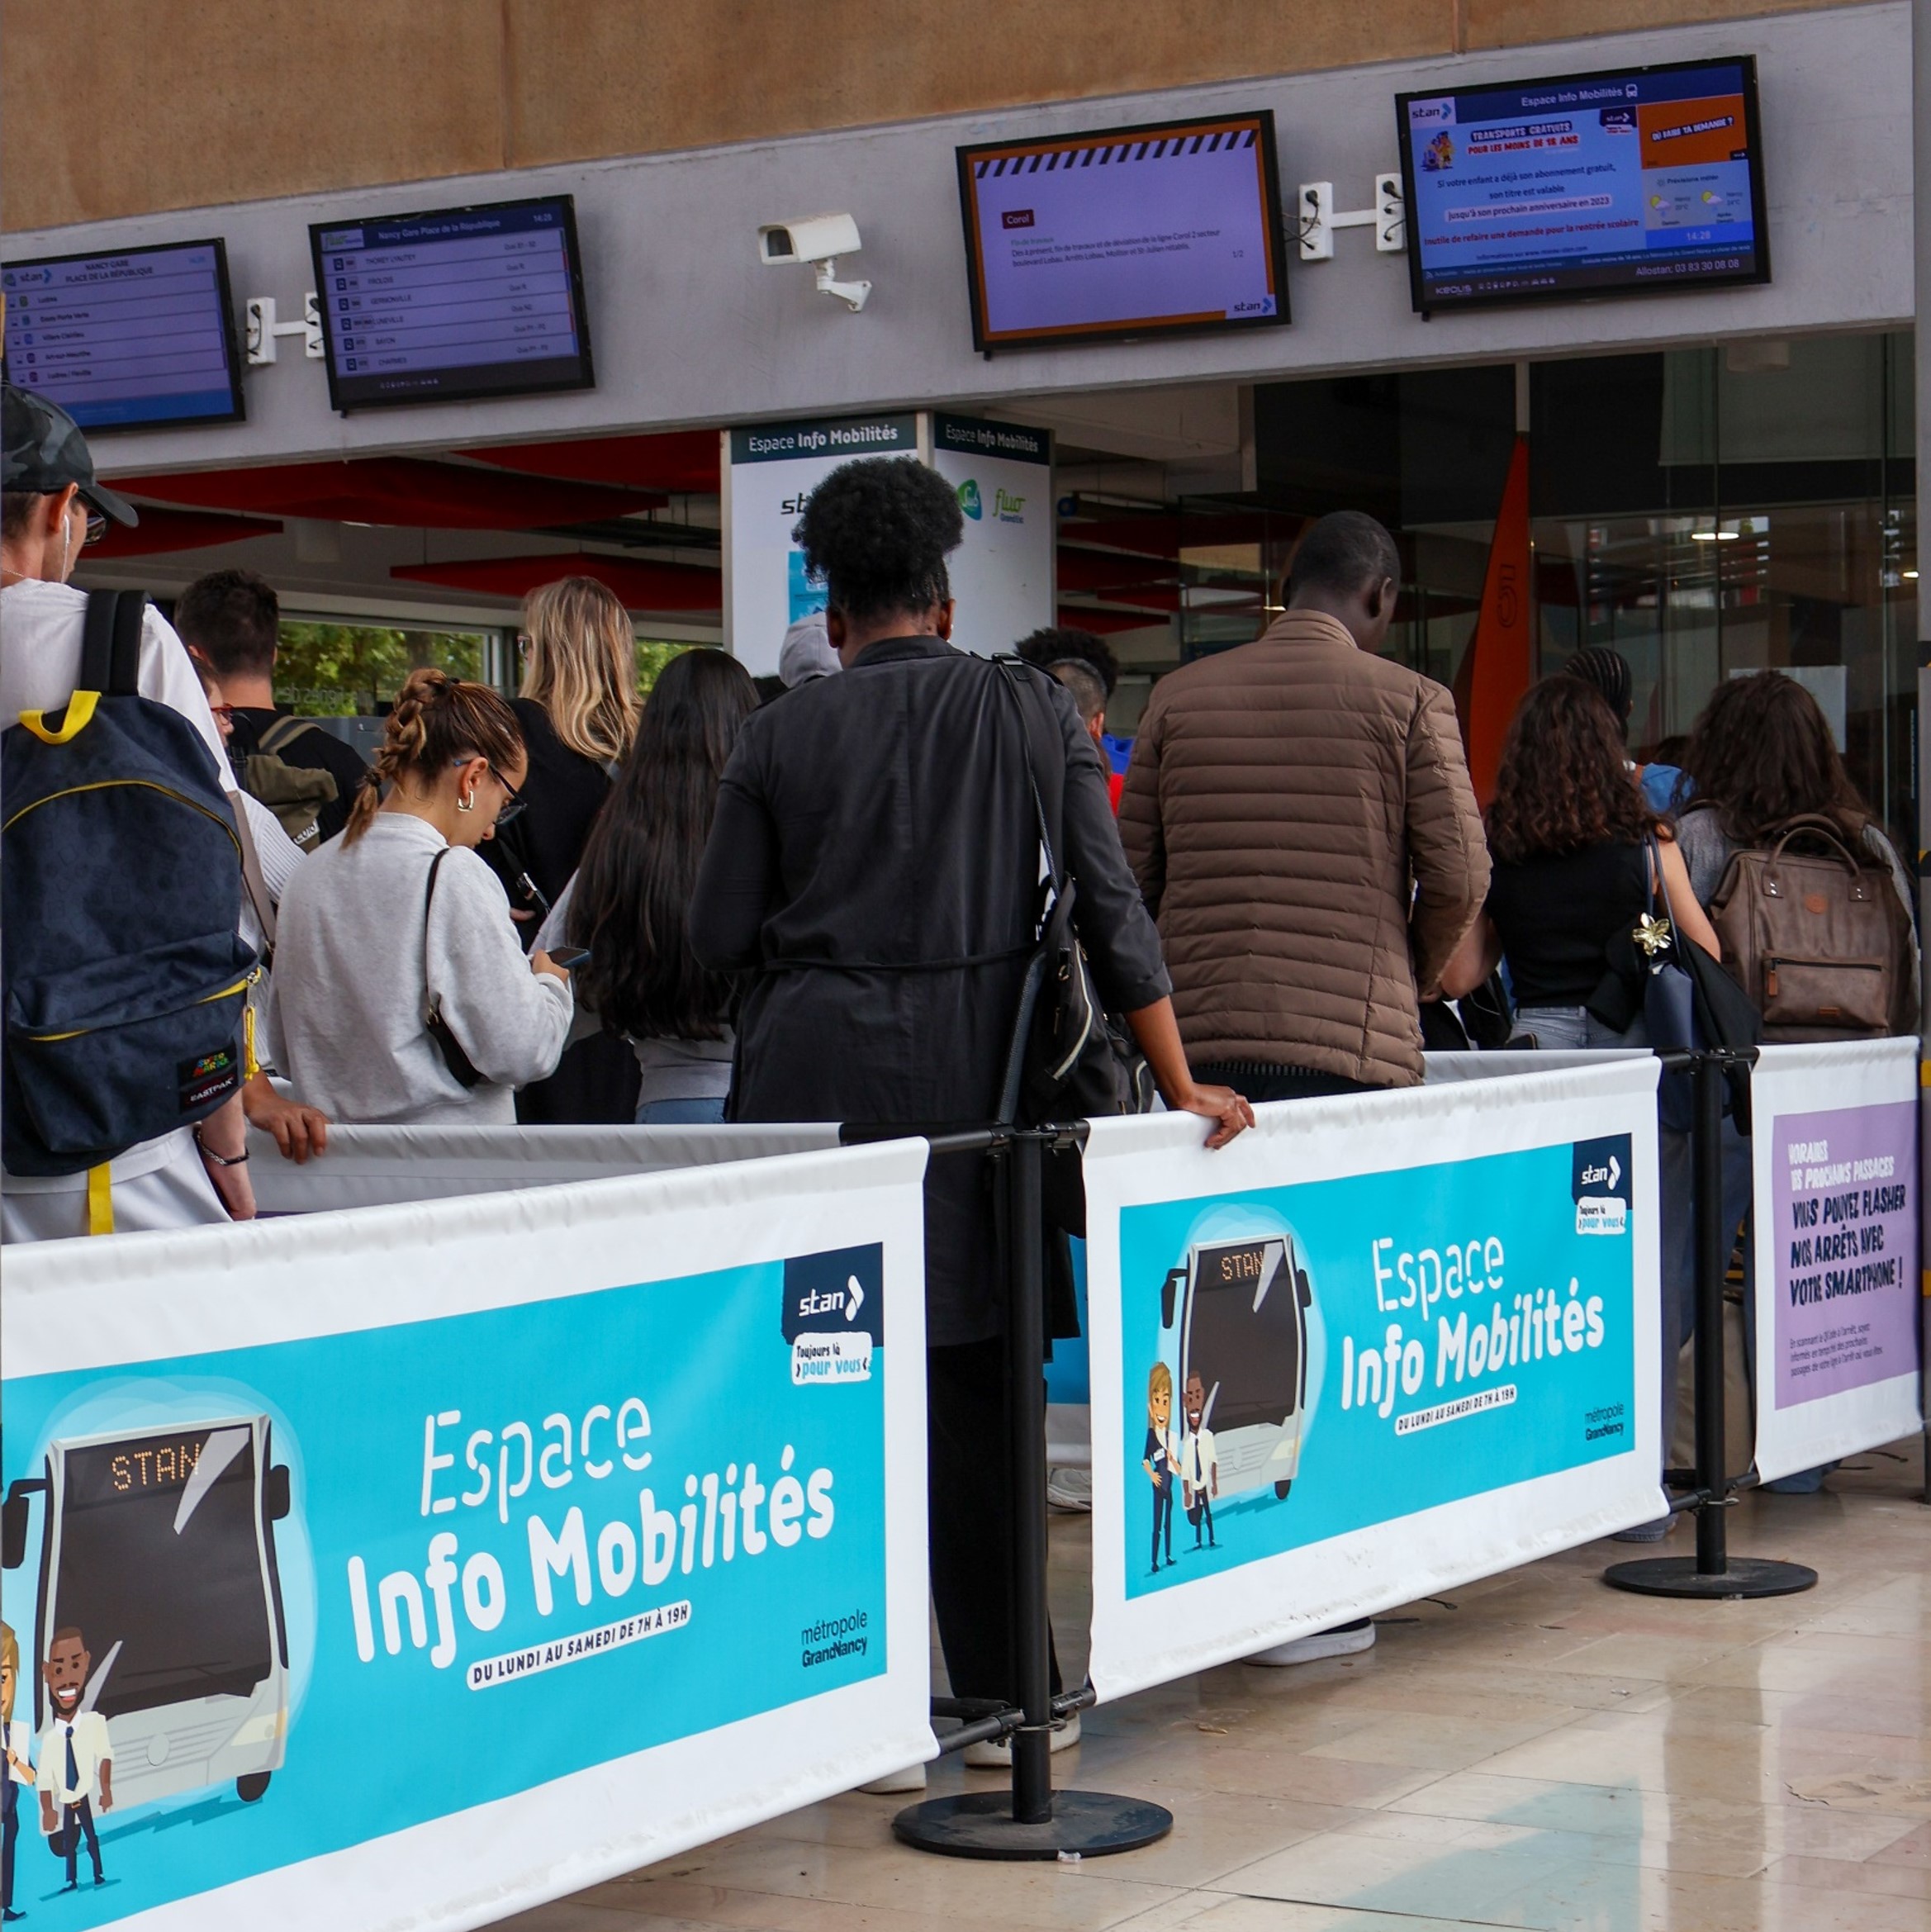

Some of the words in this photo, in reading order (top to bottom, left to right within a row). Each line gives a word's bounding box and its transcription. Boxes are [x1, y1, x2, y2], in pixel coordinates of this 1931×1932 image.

[1521, 96, 1556, 108] Espace
[1559, 92, 1577, 102] Info
[1579, 87, 1623, 100] Mobilités
[1412, 107, 1440, 118] stan
[1472, 126, 1526, 142] TRANSPORTS
[1530, 122, 1571, 135] GRATUITS
[1468, 145, 1488, 155] POUR
[1490, 143, 1502, 152] LES
[1504, 140, 1530, 150] MOINS
[1533, 139, 1544, 149] DE
[1559, 135, 1579, 145] ANS
[1437, 179, 1445, 188] Si
[1446, 178, 1467, 187] votre
[1468, 175, 1493, 185] enfant
[1501, 172, 1517, 183] déjà
[1535, 167, 1585, 178] abonnement
[1587, 163, 1616, 175] gratuit,
[1489, 192, 1504, 200] son
[1505, 189, 1521, 197] titre
[1536, 185, 1565, 195] valable
[1478, 209, 1492, 217] son
[1493, 205, 1527, 216] prochain
[1529, 200, 1578, 211] anniversaire
[1590, 196, 1610, 206] 2023
[378, 230, 401, 241] Nancy
[402, 229, 420, 238] Gare
[420, 226, 439, 235] Place
[442, 224, 451, 232] de
[452, 223, 459, 231] la
[460, 219, 501, 231] République
[1006, 213, 1030, 225] Corol
[1173, 231, 1191, 240] Corol
[1197, 230, 1220, 238] secteur
[1425, 235, 1449, 245] Inutile
[1451, 235, 1461, 243] de
[1463, 233, 1489, 242] refaire
[1490, 231, 1506, 240] une
[1507, 227, 1544, 238] demande
[1545, 227, 1564, 236] pour
[1566, 224, 1573, 232] la
[1575, 220, 1605, 231] rentrée
[1606, 218, 1639, 229] scolaire
[1687, 230, 1711, 240] 14:28
[85, 260, 109, 270] NANCY
[110, 259, 129, 268] GARE
[1013, 258, 1043, 268] boulevard
[1635, 265, 1673, 276] Allostan:
[1674, 263, 1686, 273] 03
[1687, 263, 1700, 272] 83
[1701, 261, 1713, 271] 30
[1715, 260, 1726, 270] 08
[1728, 259, 1739, 268] 08
[19, 272, 42, 282] stan
[65, 274, 88, 282] PLACE
[88, 273, 98, 281] DE
[1234, 301, 1261, 312] stan
[749, 435, 795, 453] Espace
[797, 432, 826, 450] Info
[830, 423, 899, 444] Mobilités
[946, 425, 976, 443] Espace
[977, 429, 996, 445] Info
[996, 430, 1039, 453] Mobilités
[190, 1077, 233, 1102] EASTPAK
[1788, 1140, 1829, 1165] HORAIRES
[1581, 1164, 1608, 1184] stan
[1805, 1162, 1852, 1189] PROCHAINS
[1853, 1156, 1895, 1183] PASSAGES
[1579, 1205, 1599, 1217] Toujours
[1792, 1199, 1819, 1229] VOUS
[1823, 1191, 1859, 1224] POUVEZ
[1862, 1184, 1906, 1217] FLASHER
[1582, 1218, 1600, 1231] pour
[1601, 1217, 1620, 1228] vous
[1791, 1237, 1812, 1270] NOS
[1815, 1223, 1858, 1263] ARRÊTS
[1861, 1224, 1884, 1255] AVEC
[1221, 1251, 1264, 1281] STAN
[1372, 1236, 1504, 1322] Espace
[1790, 1274, 1823, 1307] VOTRE
[1825, 1258, 1895, 1300] SMARTPHONE
[1898, 1256, 1903, 1289] !
[798, 1289, 845, 1317] stan
[796, 1344, 830, 1360] Toujours
[833, 1341, 840, 1355] là
[1341, 1323, 1425, 1418] Info
[1435, 1277, 1605, 1387] Mobilités
[802, 1361, 831, 1379] pour
[836, 1358, 861, 1374] vous
[1398, 1417, 1409, 1431] DU
[1411, 1410, 1434, 1427] LUNDI
[1435, 1407, 1445, 1420] AU
[1446, 1398, 1473, 1417] SAMEDI
[1474, 1395, 1483, 1408] DE
[1484, 1393, 1493, 1406] 7H
[1494, 1387, 1500, 1403] À
[1502, 1388, 1515, 1401] 19H
[1585, 1401, 1624, 1424] métropole
[1586, 1422, 1624, 1441] GrandNancy
[111, 1443, 201, 1491] STAN
[421, 1398, 652, 1524] Espace
[348, 1532, 506, 1669] Info
[527, 1444, 835, 1616] Mobilités
[801, 1608, 867, 1646] métropole
[473, 1664, 493, 1683] DU
[497, 1650, 540, 1677] LUNDI
[545, 1644, 563, 1664] AU
[567, 1629, 616, 1657] SAMEDI
[619, 1621, 633, 1640] DE
[638, 1615, 652, 1634] 7H
[655, 1607, 663, 1628] À
[667, 1604, 688, 1624] 19H
[801, 1636, 867, 1668] GrandNancy
